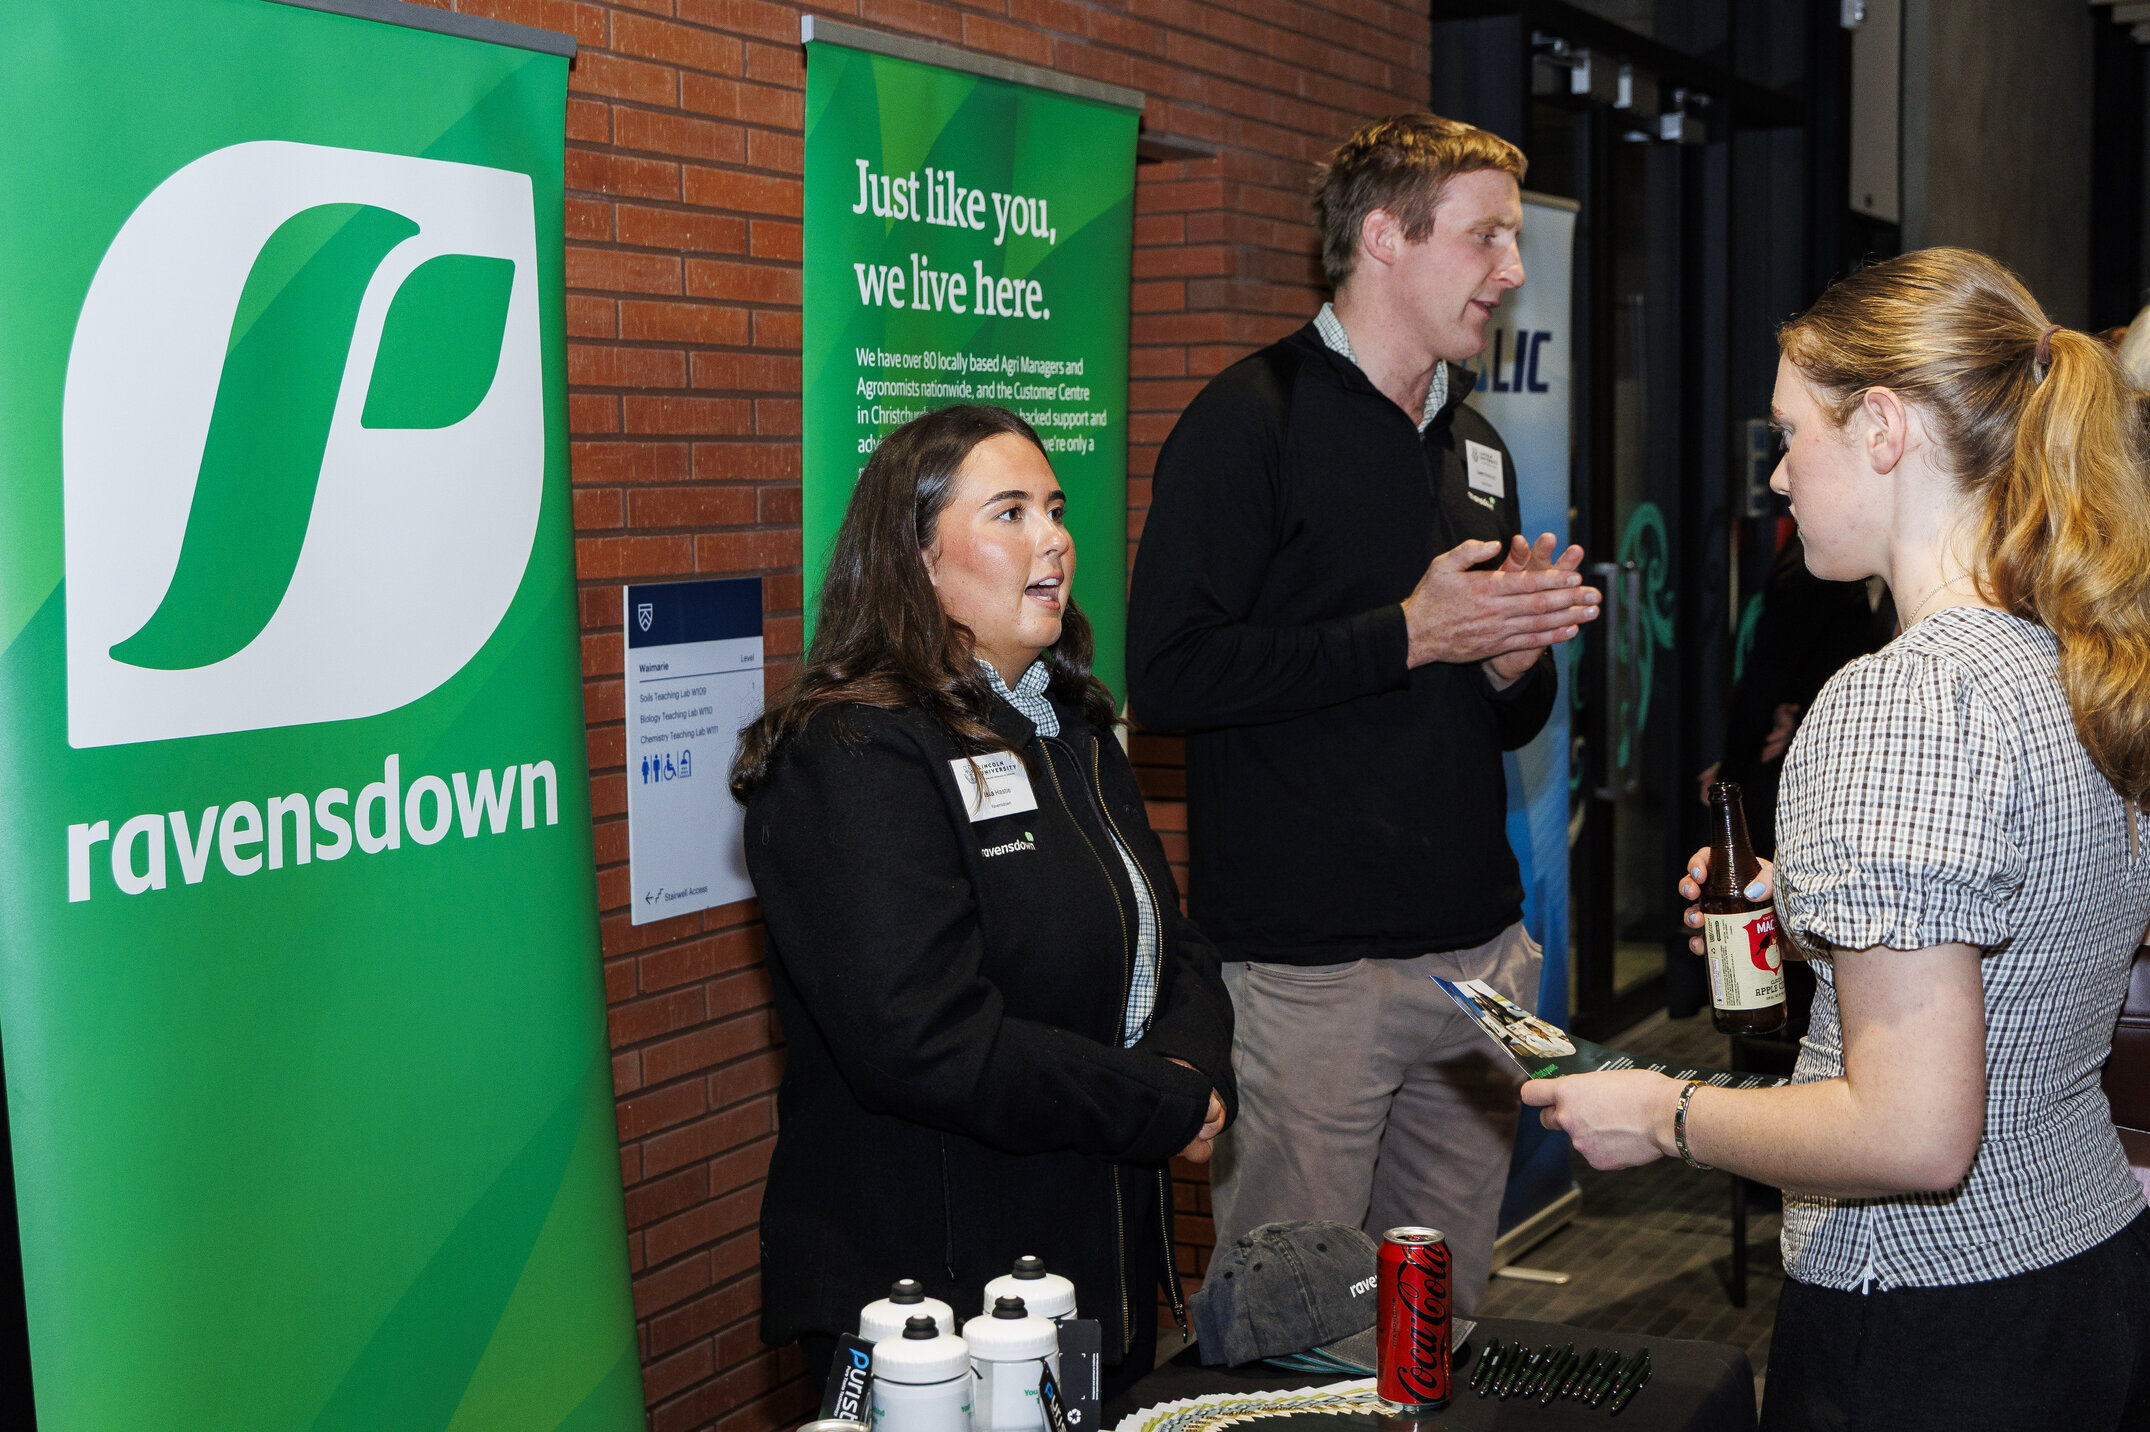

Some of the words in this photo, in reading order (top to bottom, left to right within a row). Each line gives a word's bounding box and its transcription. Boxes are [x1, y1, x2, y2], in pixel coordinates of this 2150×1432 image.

[852, 158, 920, 223] Just
[925, 167, 986, 230] like
[991, 191, 1056, 246] you,
[854, 262, 905, 309] we
[910, 253, 967, 315] live
[973, 260, 1050, 320] here.
[856, 347, 876, 367] We
[877, 347, 902, 368] have
[903, 353, 922, 369] over
[923, 351, 937, 370] 80
[937, 351, 968, 375] locally
[970, 353, 1000, 372] based
[1000, 355, 1020, 377] Agri
[1020, 356, 1064, 378] Managers
[1065, 358, 1084, 376] and
[1492, 328, 1553, 393] LIC
[856, 376, 920, 400] Agronomists
[921, 379, 975, 400] nationwide,
[976, 380, 995, 399] and
[997, 381, 1013, 399] the
[1013, 382, 1057, 400] Customer
[1058, 383, 1090, 401] Centre
[857, 405, 869, 424] in
[1053, 411, 1089, 430] support
[1090, 408, 1108, 427] and
[1067, 434, 1088, 456] only
[1088, 438, 1095, 452] a
[639, 661, 670, 673] Waimarie
[740, 652, 755, 663] Level
[640, 691, 654, 703] Soils
[654, 689, 680, 701] Teaching
[680, 688, 691, 698] Lab
[640, 713, 661, 724] Biology
[662, 709, 687, 720] Teaching
[688, 708, 698, 717] Lab
[640, 732, 669, 744] Chemistry
[670, 728, 695, 740] Teaching
[695, 727, 706, 736] Lab
[68, 752, 559, 903] ravensdown
[688, 886, 708, 896] Access
[1756, 919, 1775, 935] MAC
[1755, 984, 1778, 996] APPLE
[1350, 1274, 1377, 1298] rave
